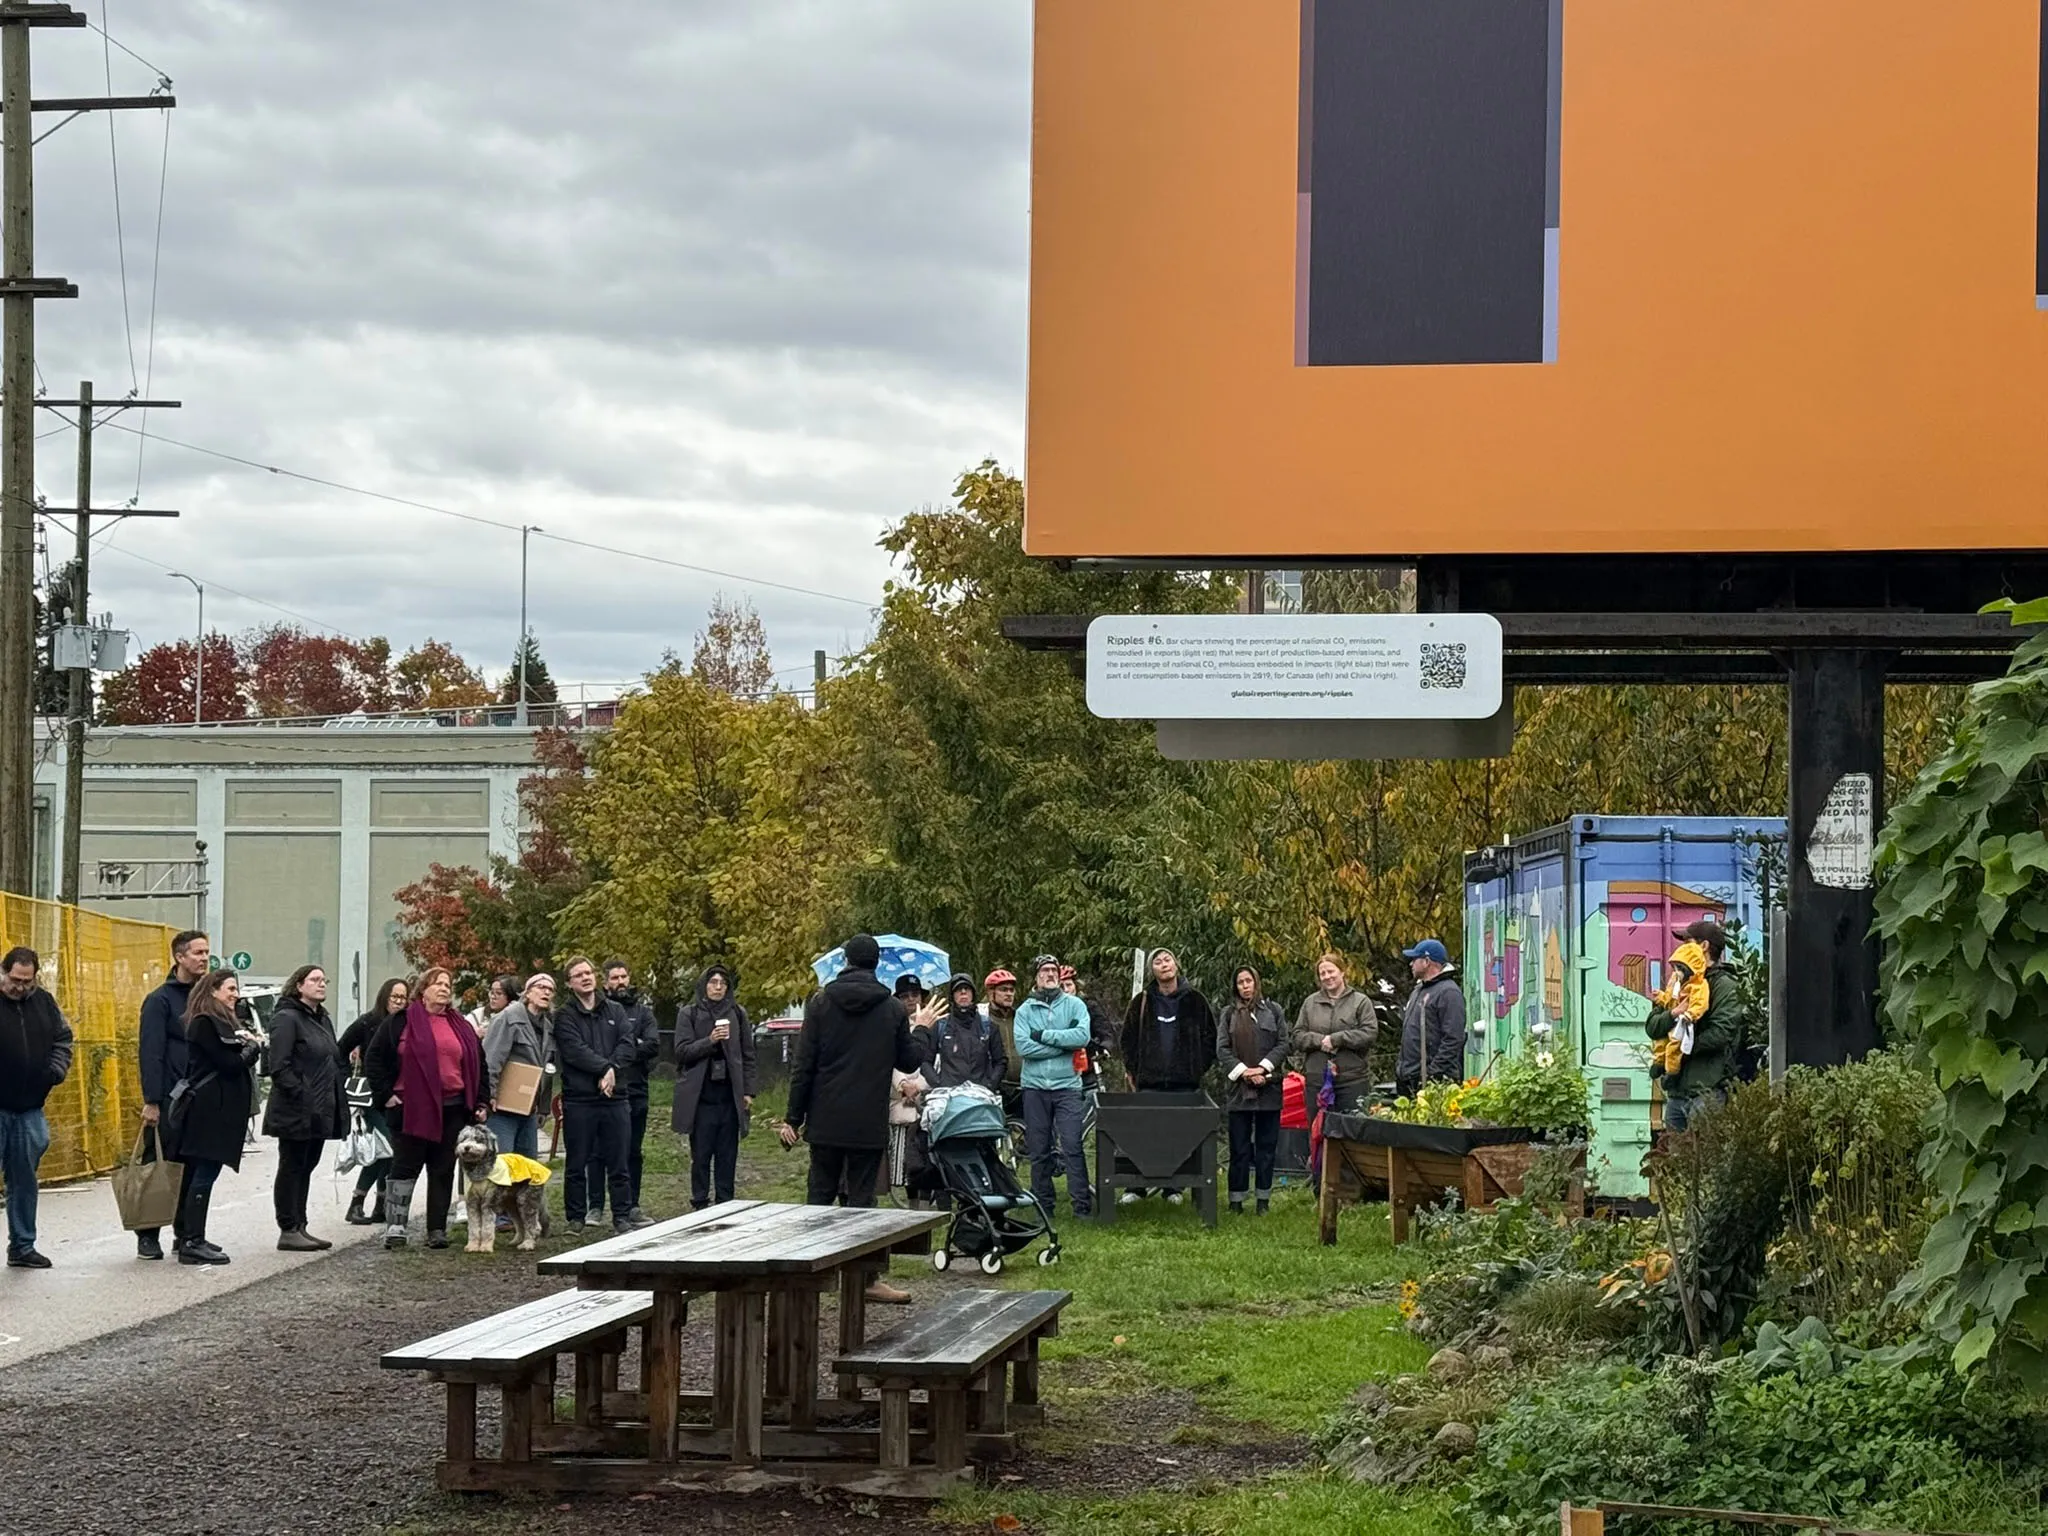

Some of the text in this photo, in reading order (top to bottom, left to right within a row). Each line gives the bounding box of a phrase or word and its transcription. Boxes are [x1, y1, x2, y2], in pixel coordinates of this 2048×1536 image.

[1106, 636, 1144, 646] Ripples
[1148, 636, 1164, 645] #6.
[1204, 638, 1234, 646] showing
[1250, 638, 1290, 646] percentage
[1281, 649, 1345, 657] production-based
[1252, 672, 1272, 680] 2019,
[1316, 672, 1333, 680] (left)
[1374, 672, 1398, 680] (right).
[1230, 690, 1353, 698] globalreportingcentre.org/ripples
